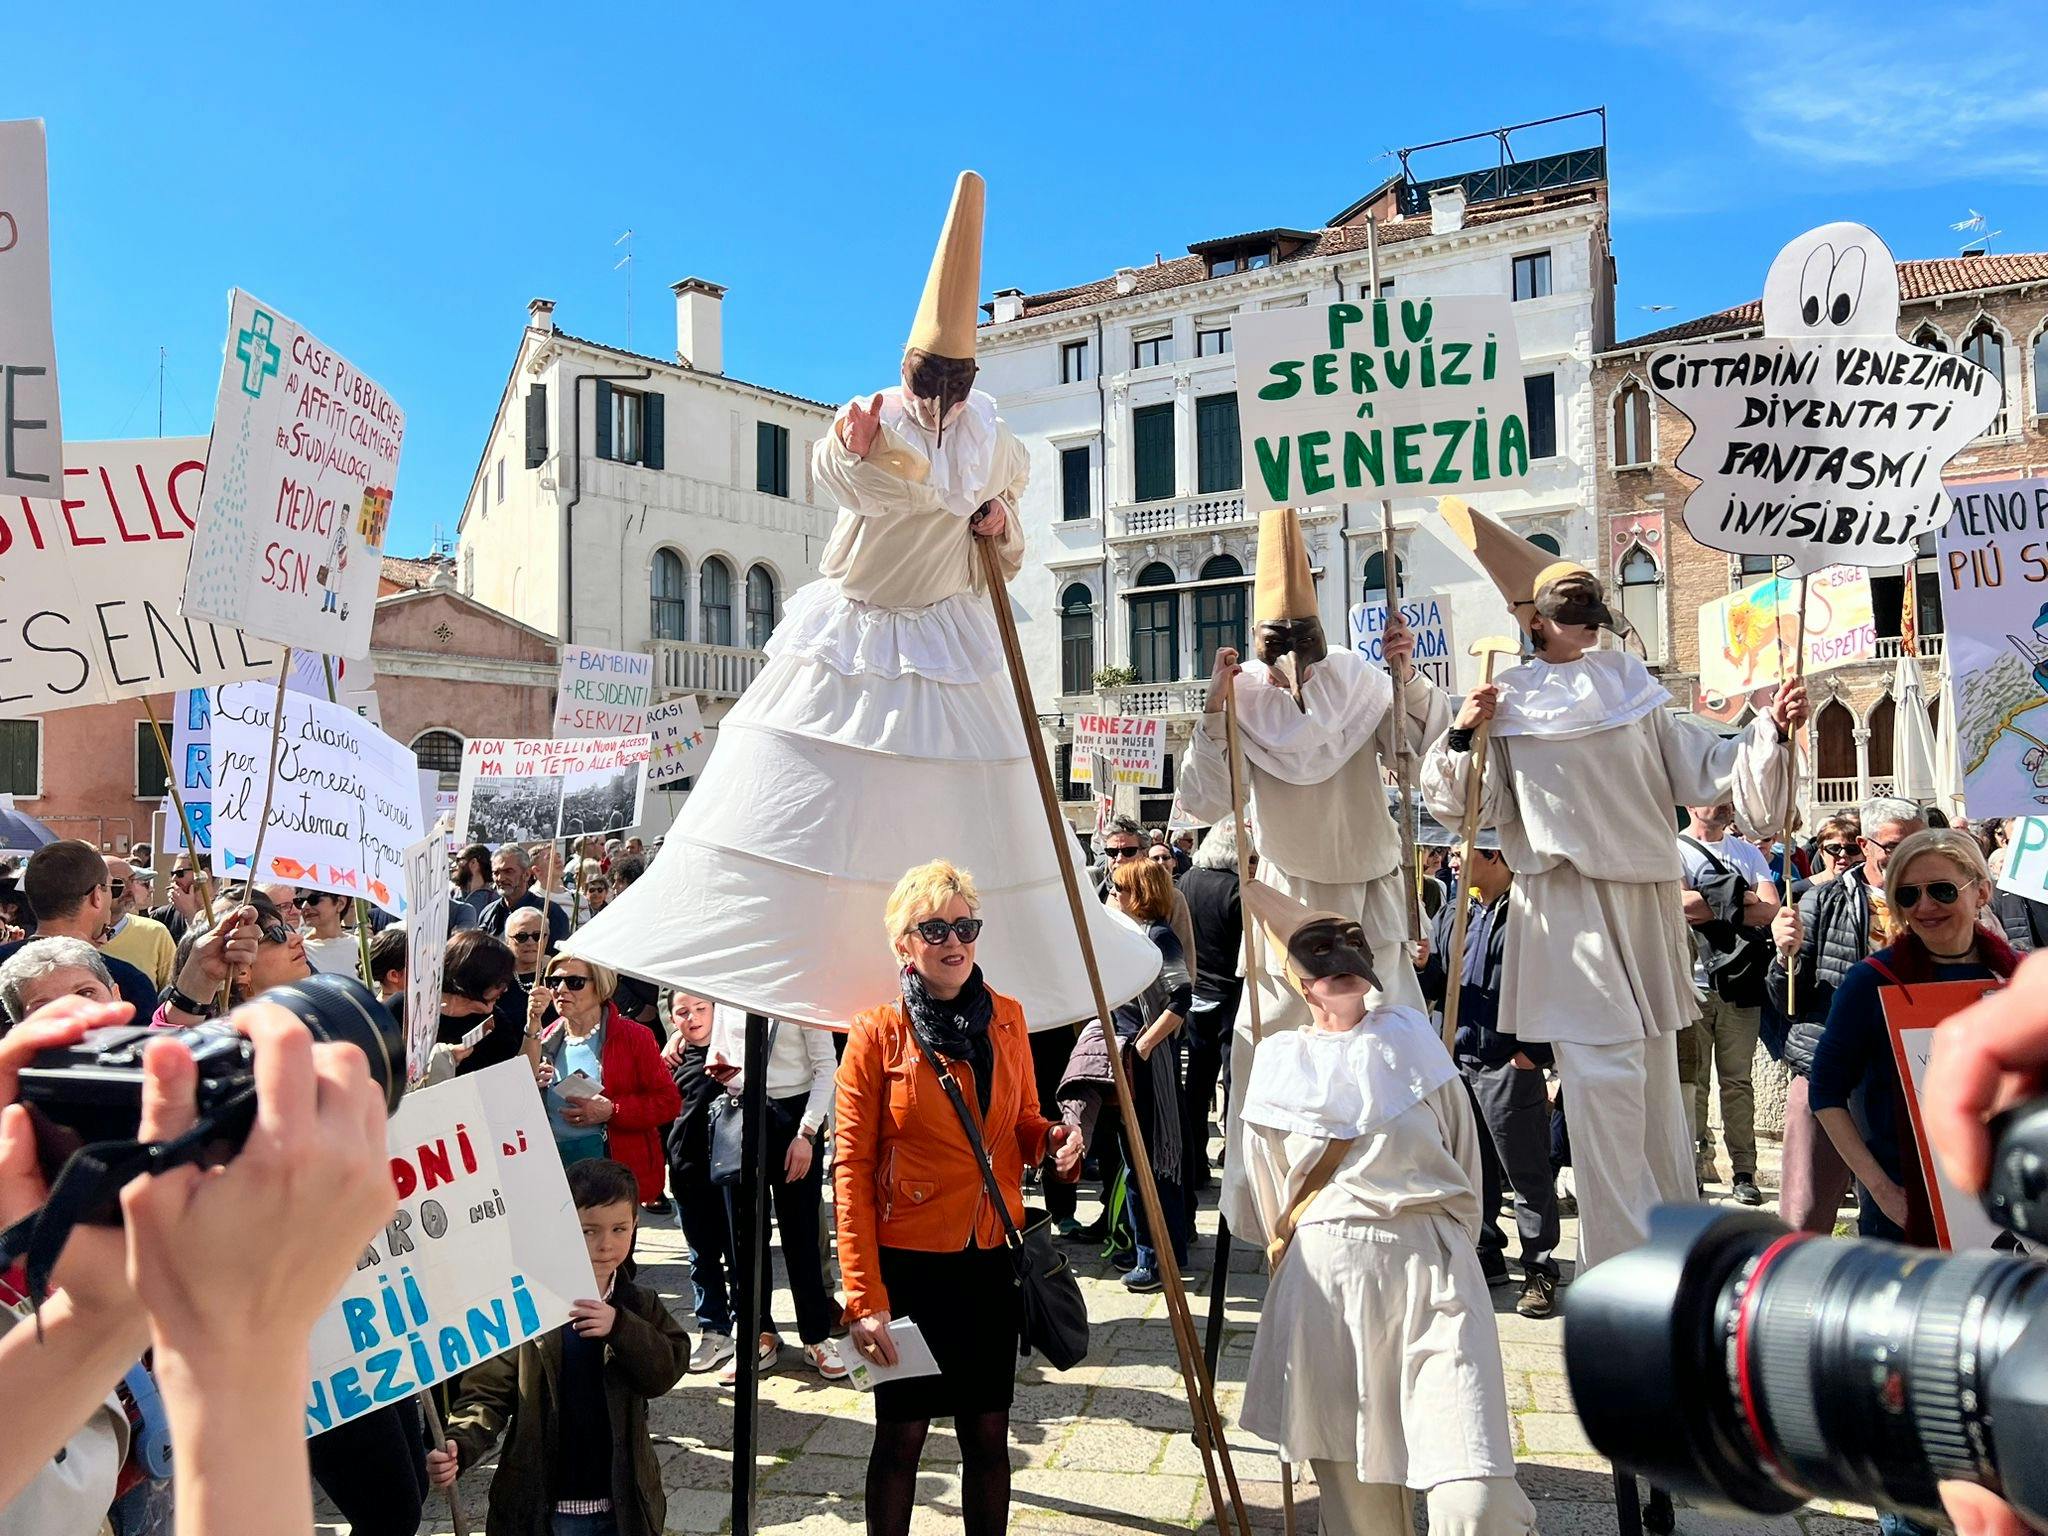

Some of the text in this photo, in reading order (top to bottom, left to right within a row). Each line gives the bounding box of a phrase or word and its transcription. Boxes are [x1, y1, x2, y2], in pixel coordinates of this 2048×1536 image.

[293, 335, 331, 378] CASE
[334, 361, 400, 434] PUBBLICHE
[1258, 333, 1497, 400] SERVIZI
[1651, 344, 1985, 397] CITTADINI VENEZIANI
[284, 372, 299, 393] AD
[296, 381, 348, 437] AFFITTI
[1357, 402, 1374, 418] A
[1735, 393, 1954, 432] DIVENTATI
[276, 426, 290, 450] PER
[1254, 407, 1529, 501] VENEZIA
[1718, 441, 1932, 490] FANTASMI
[275, 476, 336, 539] MEDICI
[261, 541, 308, 597] S.S.N.
[1831, 566, 1862, 588] ESIGE
[1352, 600, 1441, 634] VENSSIA
[1811, 624, 1877, 664] RISPETTO
[667, 726, 678, 737] DI
[1080, 715, 1157, 736] VENEZIA
[468, 740, 504, 756] NON
[513, 737, 584, 756] TORNELLI
[480, 760, 503, 776] MA
[515, 760, 535, 776] UN
[540, 755, 584, 776] TETTO
[588, 753, 614, 771] ALLE
[218, 749, 258, 789] per
[278, 736, 366, 802] Venezia
[647, 761, 685, 779] CASA
[218, 776, 251, 822] il
[266, 791, 350, 842] sistema
[502, 1129, 528, 1157] DI
[469, 1188, 507, 1224] NEI
[341, 1266, 430, 1354] RII
